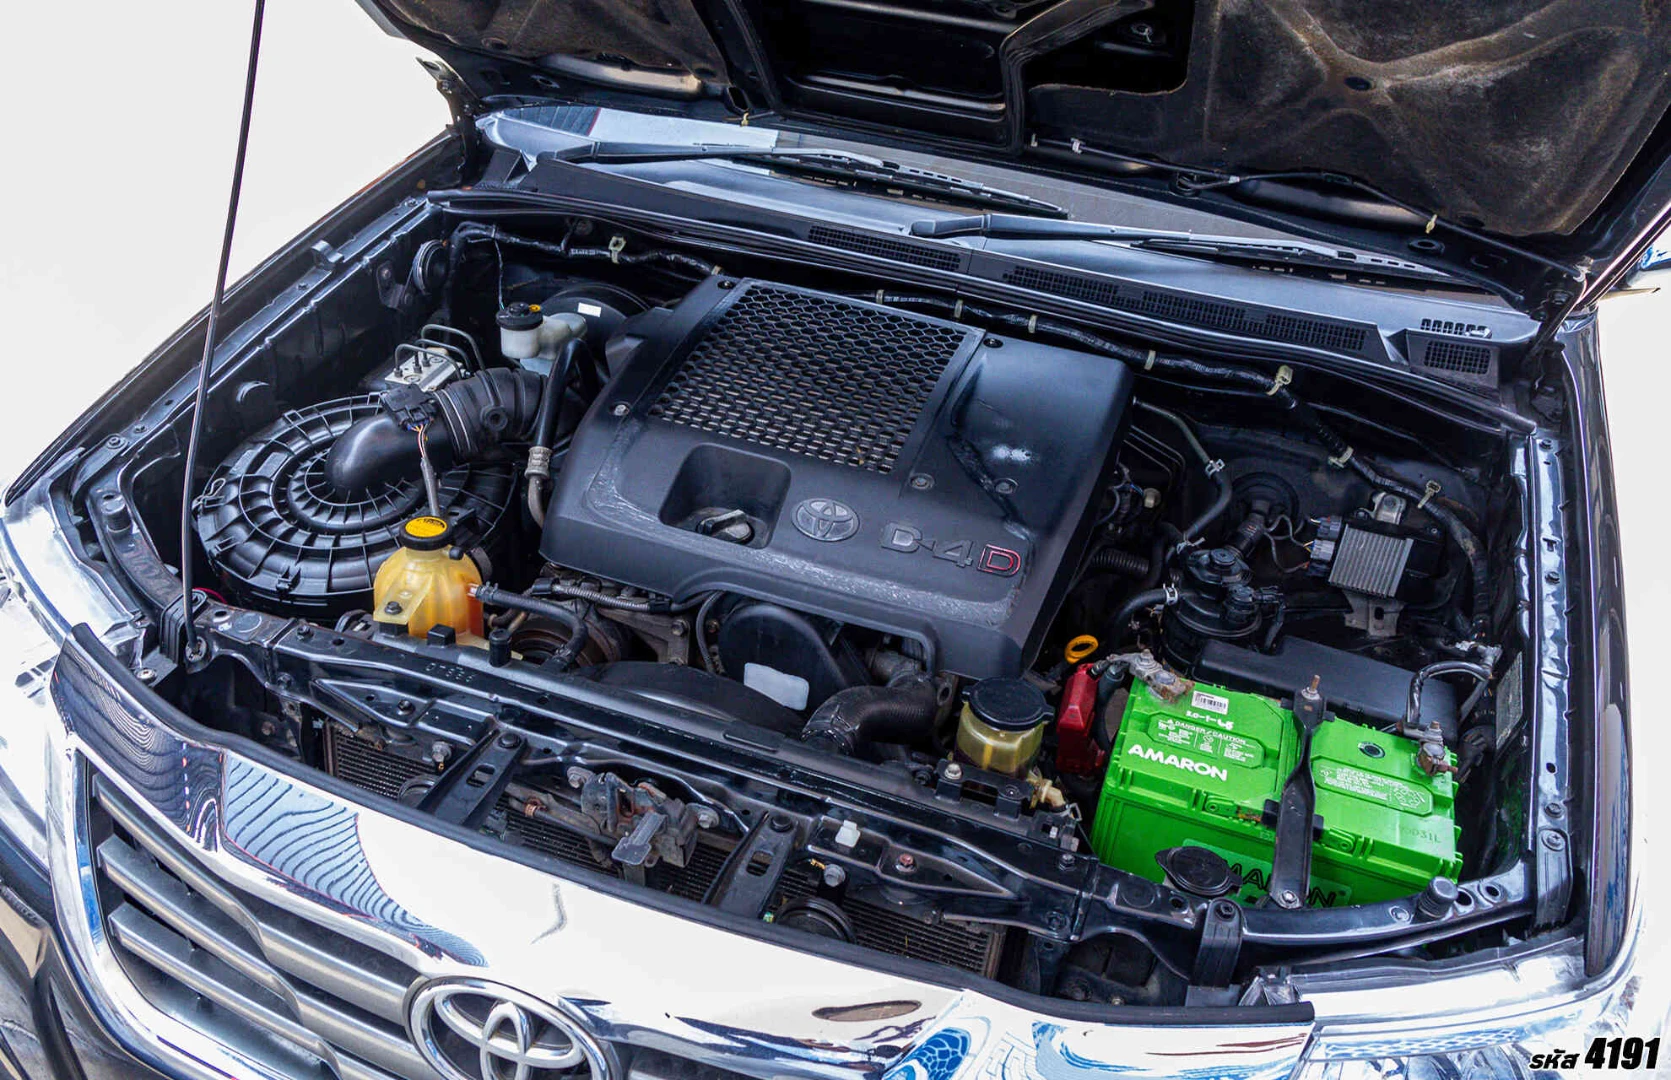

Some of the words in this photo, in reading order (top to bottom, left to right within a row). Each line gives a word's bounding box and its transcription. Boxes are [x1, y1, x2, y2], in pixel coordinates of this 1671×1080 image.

[1175, 720, 1206, 735] DANGER
[1213, 731, 1247, 745] CAUTION
[1128, 744, 1228, 782] AMARON
